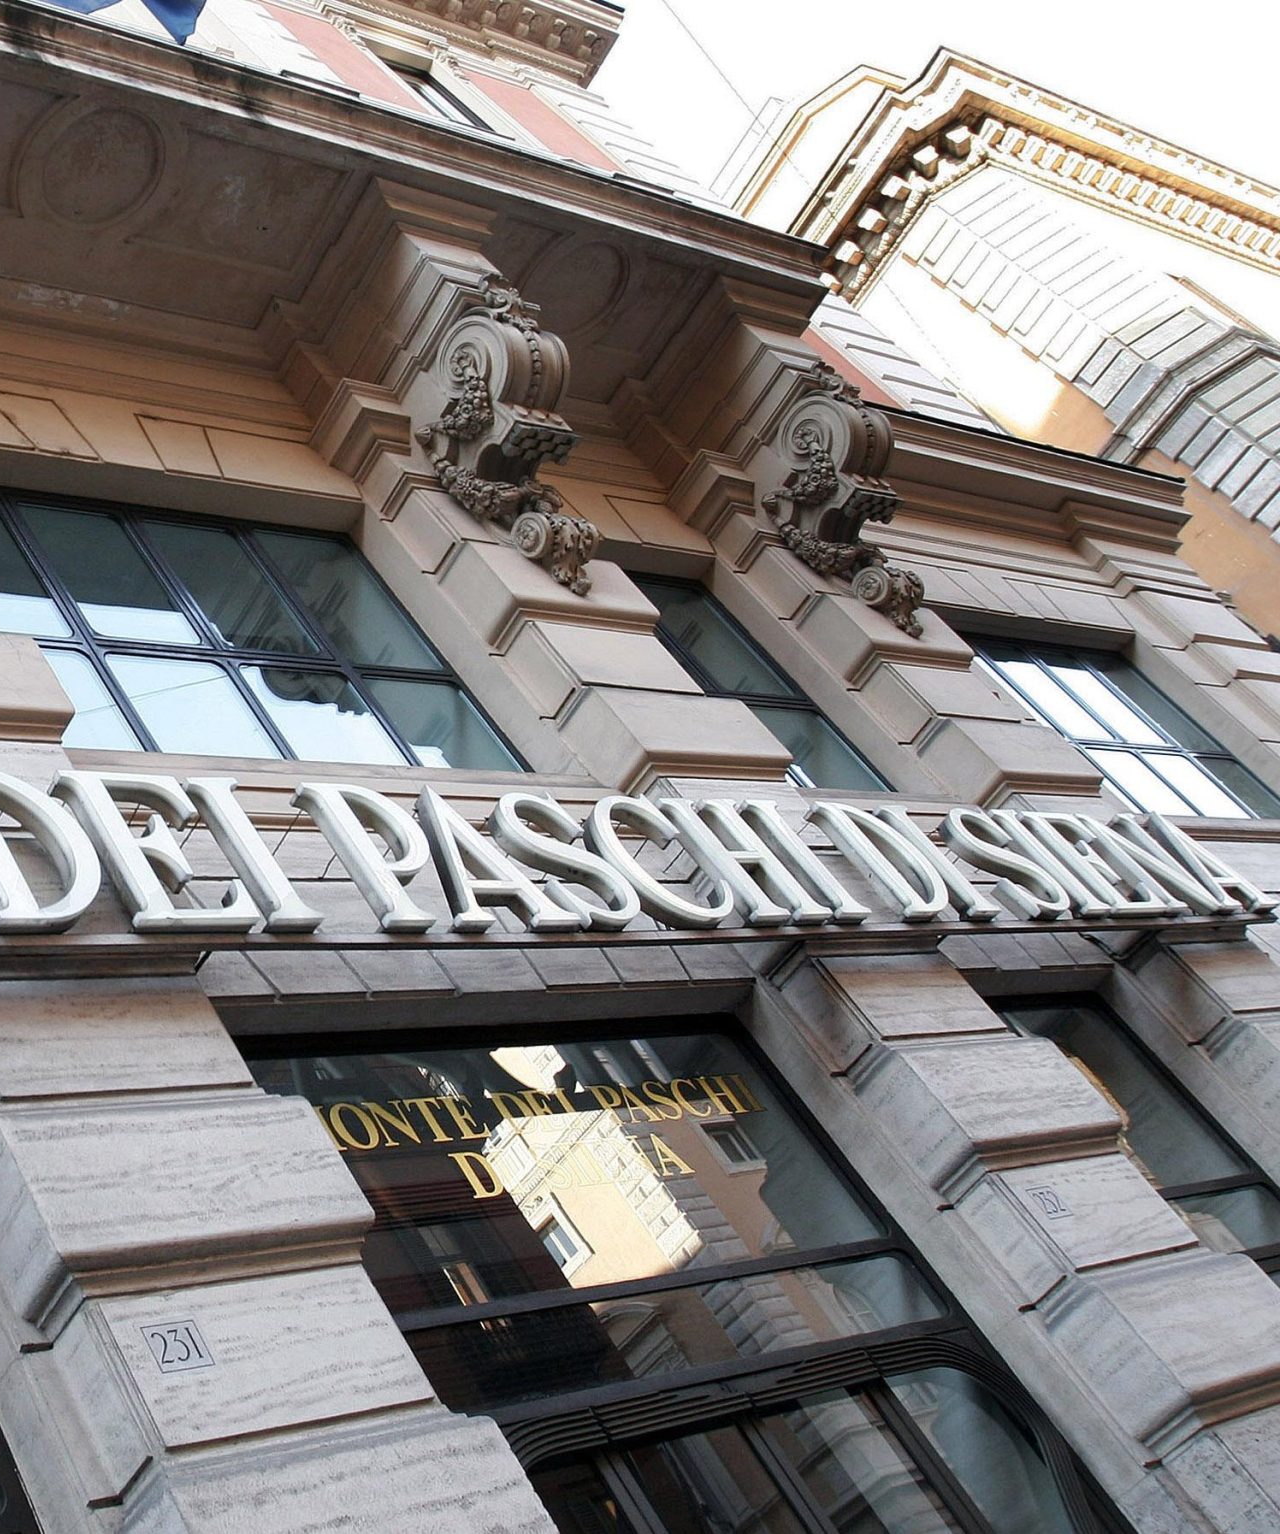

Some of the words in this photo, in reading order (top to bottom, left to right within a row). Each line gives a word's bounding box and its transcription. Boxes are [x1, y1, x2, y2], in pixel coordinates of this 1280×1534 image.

[291, 784, 871, 932] PASCHI
[803, 801, 1001, 922] DI
[937, 807, 1279, 921] SIENA
[586, 1074, 767, 1125] PASCHI
[150, 1327, 204, 1364] 231
